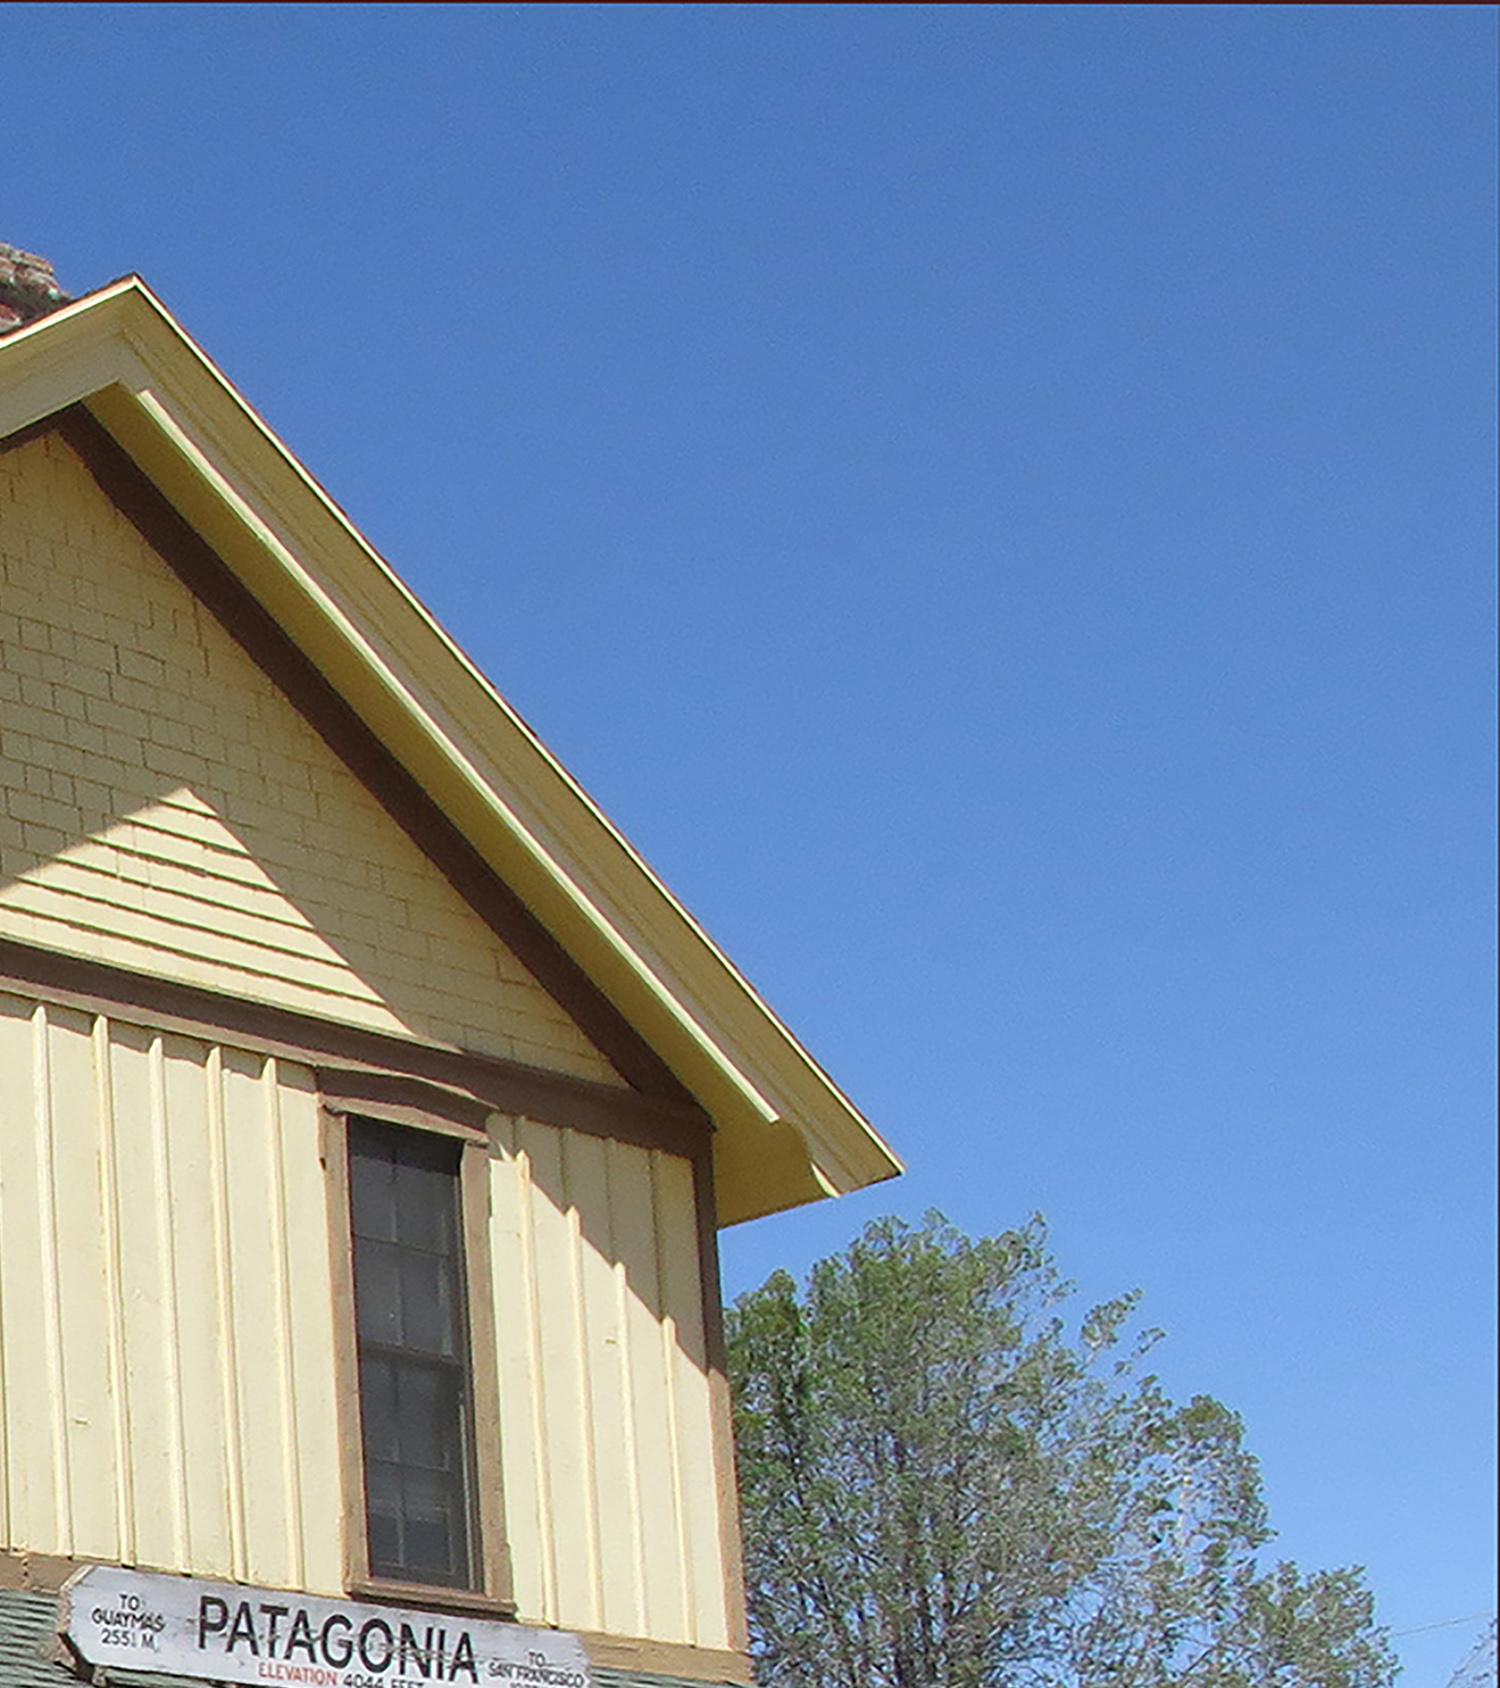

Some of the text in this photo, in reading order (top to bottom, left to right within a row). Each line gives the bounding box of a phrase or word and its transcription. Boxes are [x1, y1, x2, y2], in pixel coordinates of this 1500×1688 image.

[119, 1594, 140, 1611] TO
[91, 1607, 166, 1632] GUAYMAS
[198, 1595, 480, 1684] PATAGONIA
[529, 1651, 546, 1667] TO
[258, 1662, 337, 1686] ELEVATION
[488, 1662, 584, 1688] SAN FRANCISCO
